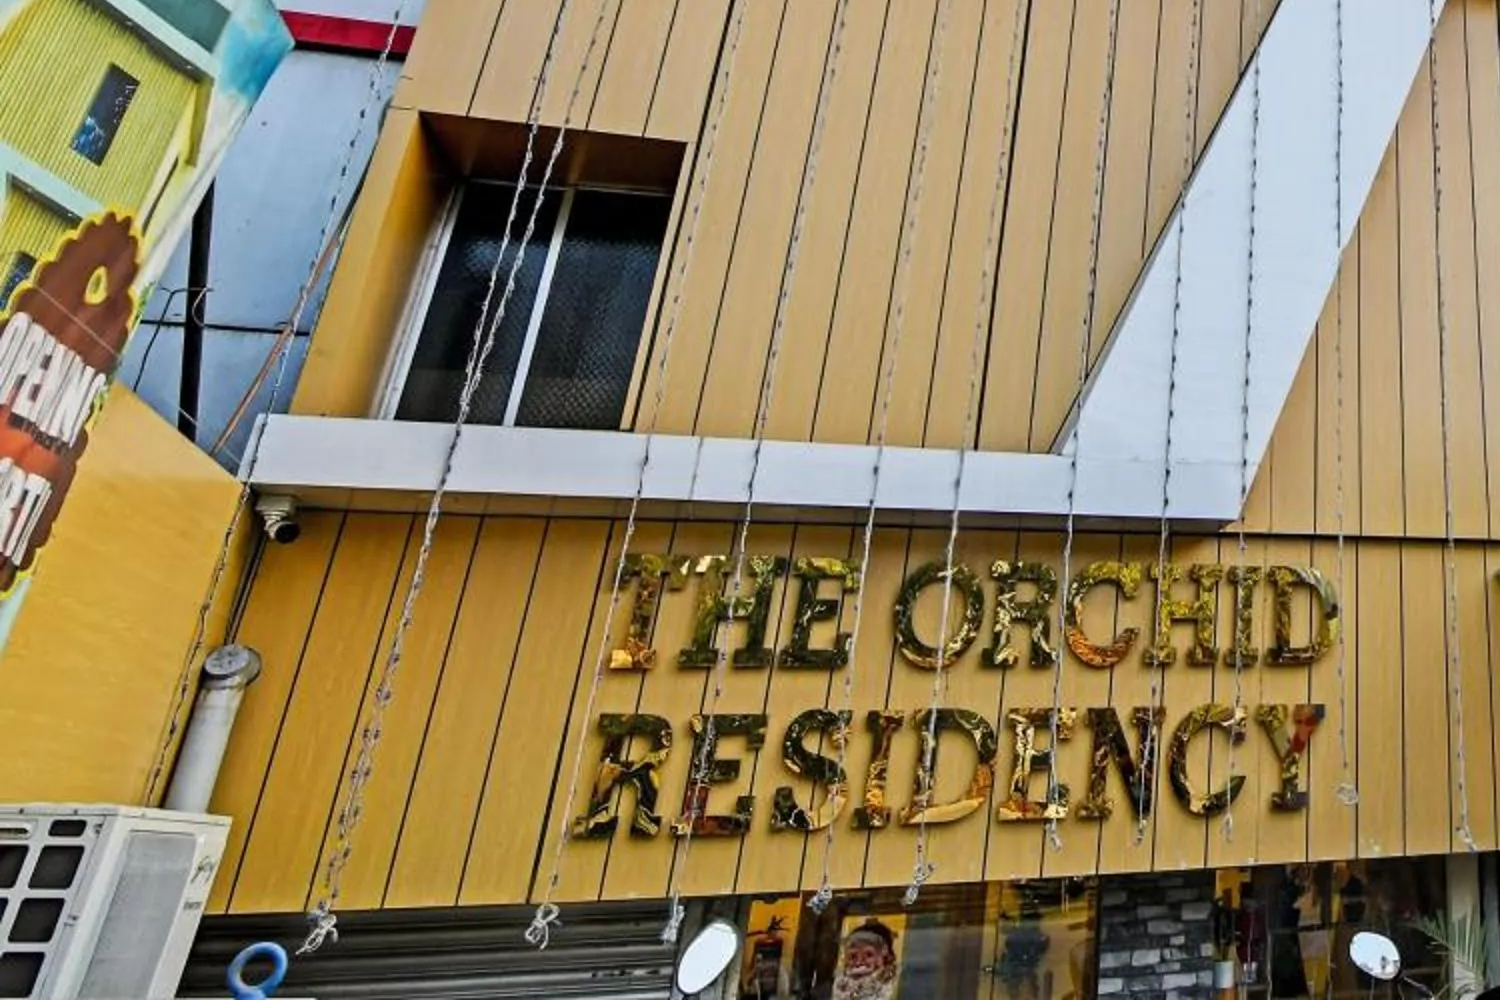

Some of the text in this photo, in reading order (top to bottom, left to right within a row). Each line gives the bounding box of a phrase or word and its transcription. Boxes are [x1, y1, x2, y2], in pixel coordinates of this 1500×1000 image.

[609, 553, 1340, 670] THE ORCHID
[573, 703, 1327, 839] RESIDENCY
